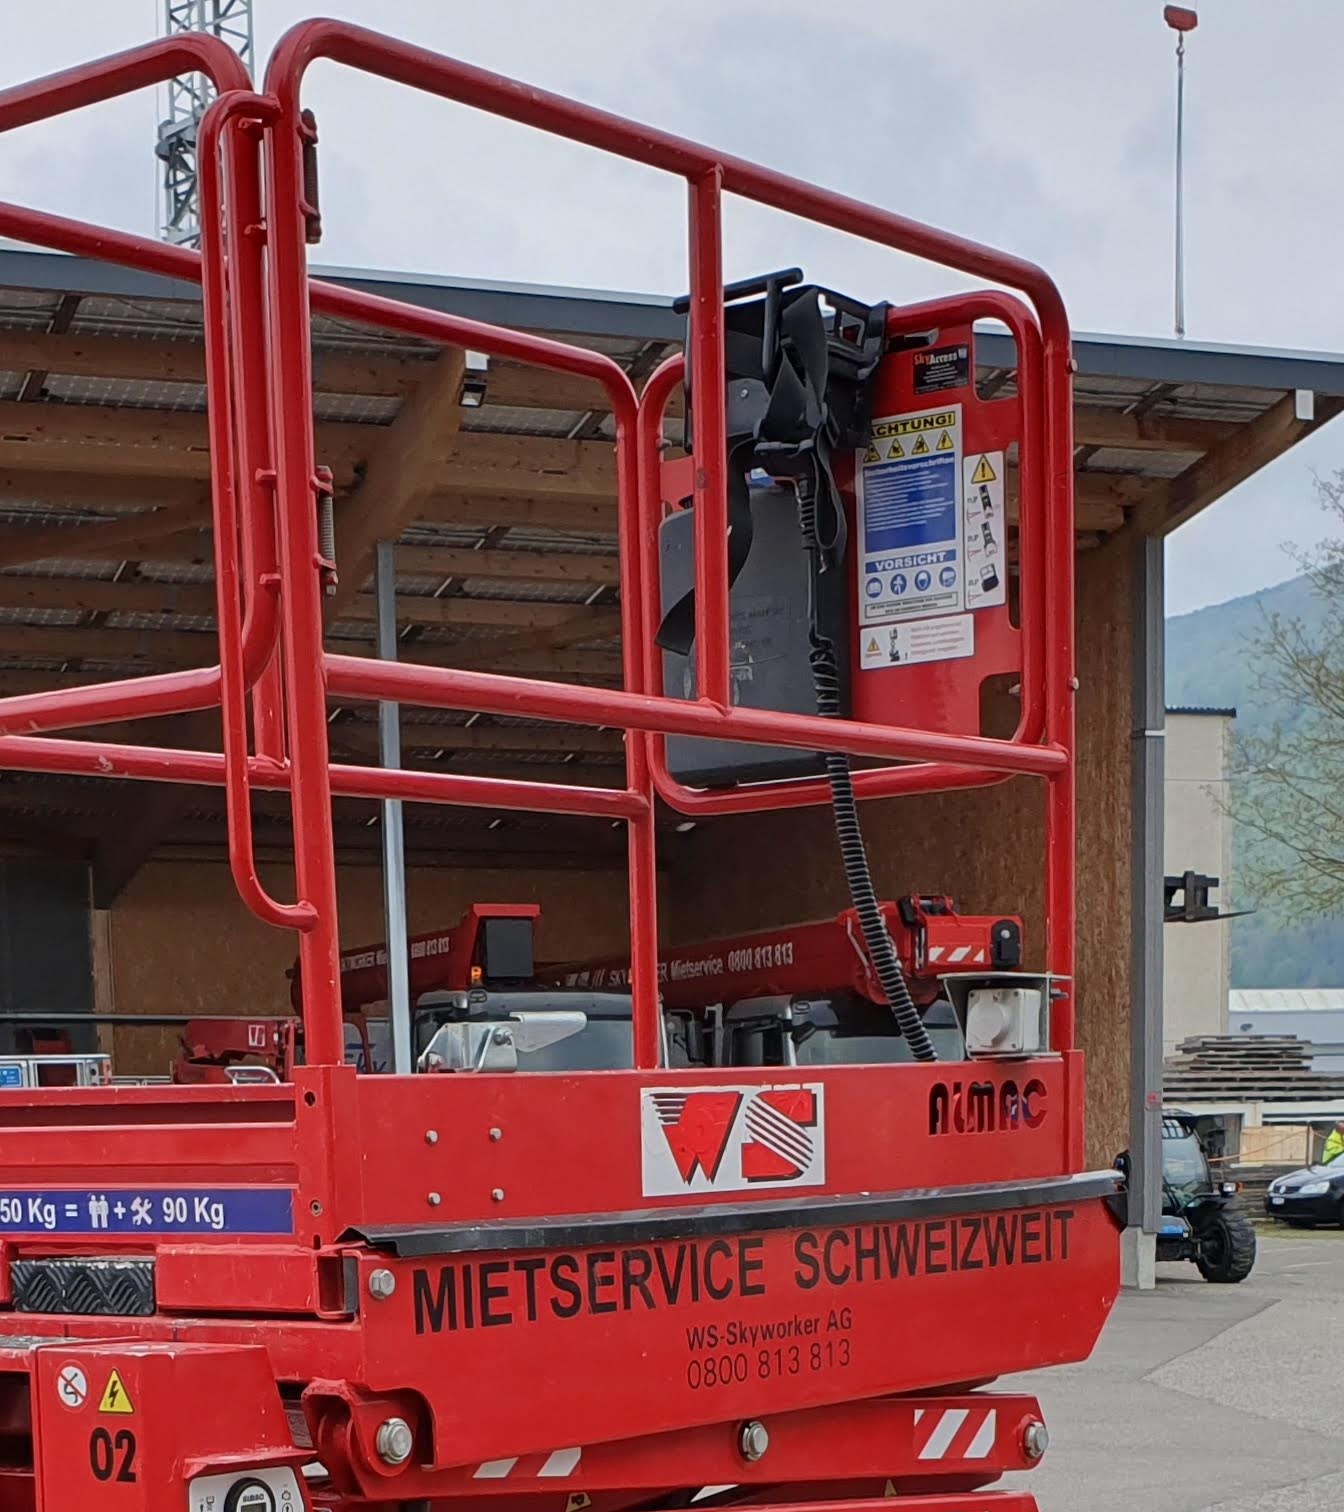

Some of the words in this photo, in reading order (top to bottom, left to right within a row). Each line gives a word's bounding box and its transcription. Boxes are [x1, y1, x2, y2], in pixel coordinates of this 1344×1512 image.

[875, 551, 947, 571] VORSICHT
[727, 947, 752, 972] 0800
[755, 946, 772, 969] 813
[775, 942, 793, 966] 813
[646, 1087, 818, 1186] WS
[28, 1197, 56, 1229] Kg
[162, 1197, 188, 1223] 90
[194, 1197, 225, 1229] Kg
[412, 1237, 765, 1336] MIETSERVICE
[794, 1210, 1075, 1290] SCHWEIZWEIT
[686, 1314, 821, 1351] WS-Skyworker
[826, 1307, 853, 1332] AG
[687, 1353, 748, 1390] 0800
[758, 1346, 800, 1379] 813
[810, 1338, 851, 1371] 813
[89, 1426, 137, 1483] 02
